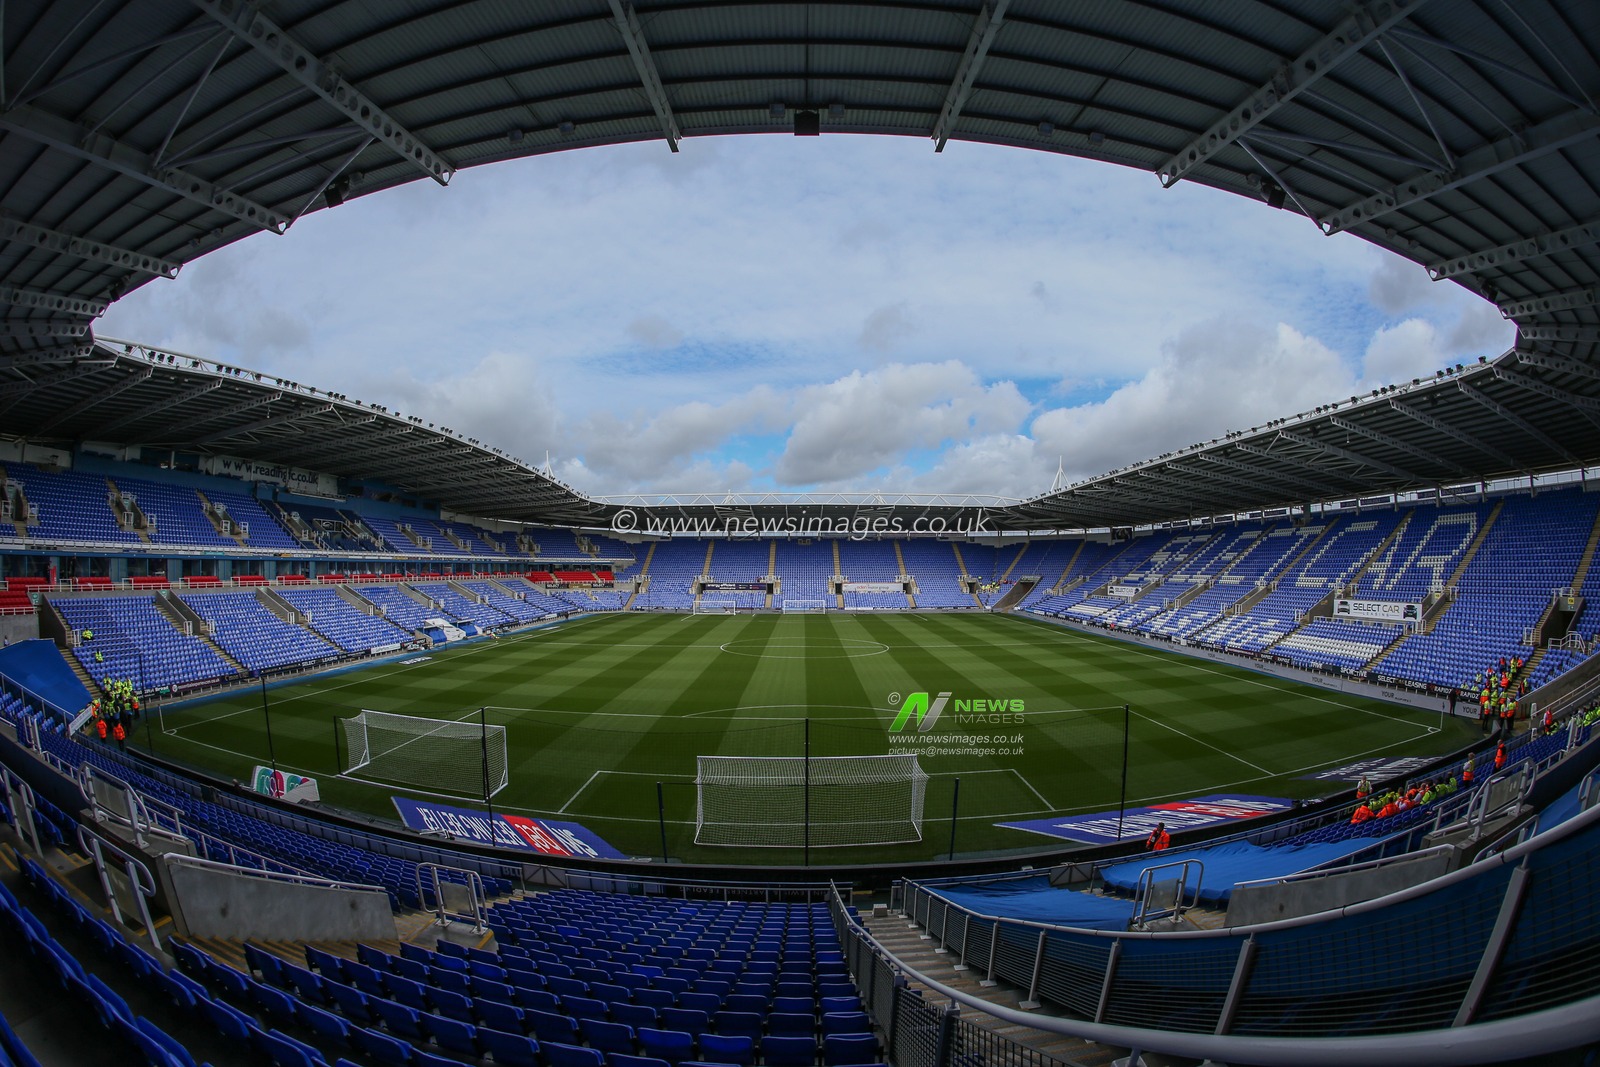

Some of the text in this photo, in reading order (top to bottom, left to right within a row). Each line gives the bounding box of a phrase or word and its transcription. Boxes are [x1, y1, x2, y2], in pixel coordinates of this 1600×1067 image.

[1353, 602, 1400, 614] SELECT CAR
[1377, 674, 1427, 690] SELECT LEASING
[1381, 690, 1394, 699] YOUR
[1462, 705, 1478, 715] YOUR
